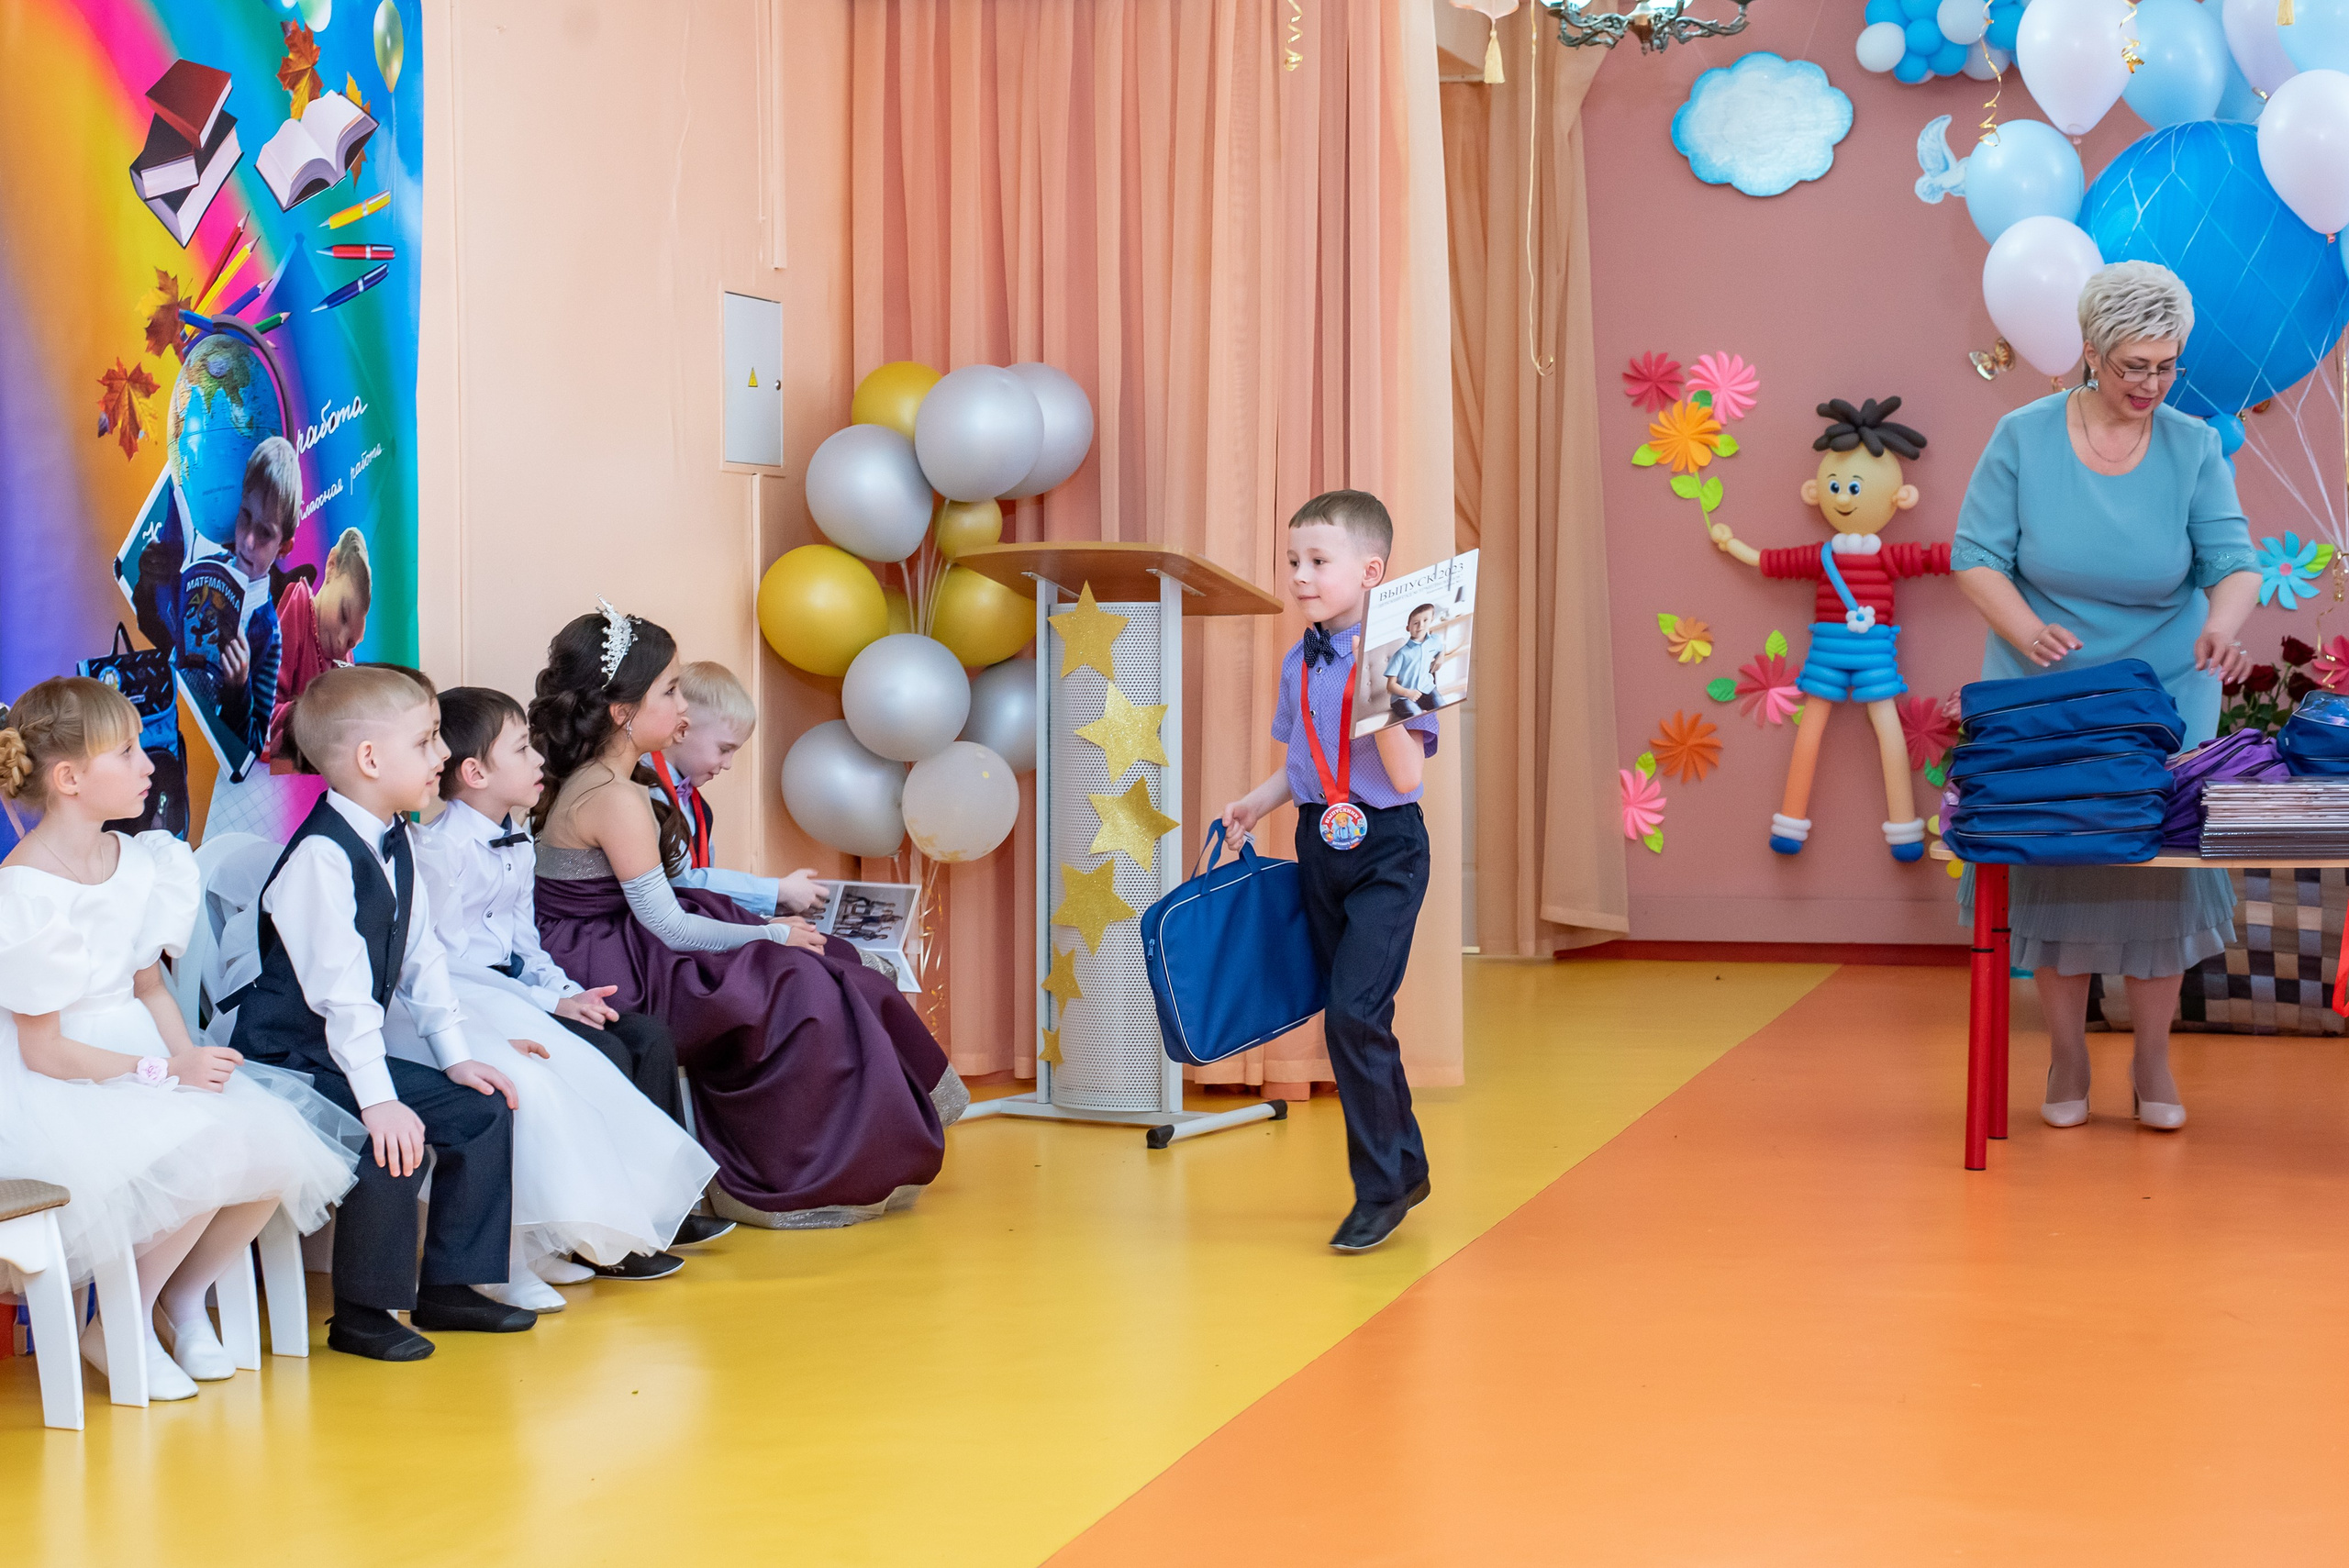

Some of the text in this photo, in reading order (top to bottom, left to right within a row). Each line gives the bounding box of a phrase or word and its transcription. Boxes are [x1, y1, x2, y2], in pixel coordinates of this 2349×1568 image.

[296, 395, 368, 460] работа
[350, 443, 384, 495] работа
[186, 576, 240, 613] МАТЕМАТИКА
[1379, 573, 1436, 602] ВЫПУСК
[1438, 562, 1464, 580] 2023
[1325, 808, 1359, 824] ВЫПУСКНИК
